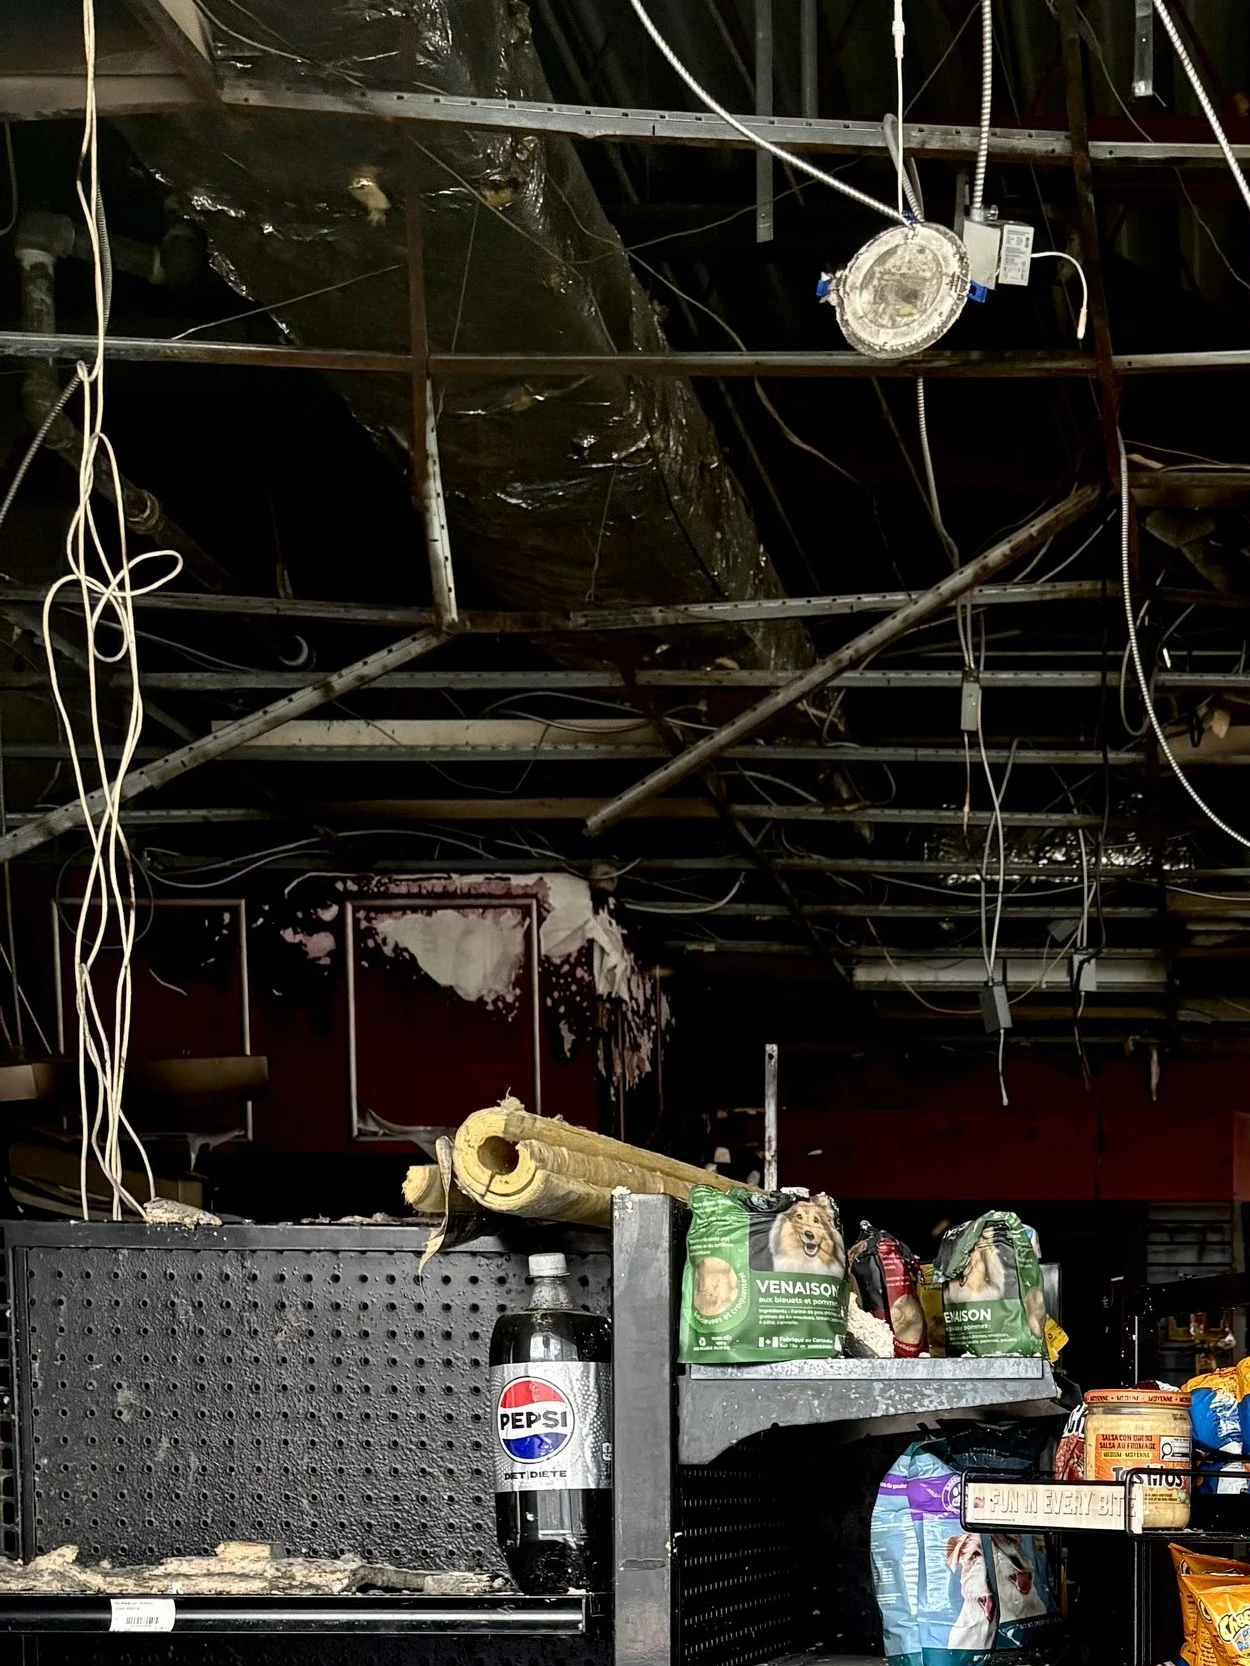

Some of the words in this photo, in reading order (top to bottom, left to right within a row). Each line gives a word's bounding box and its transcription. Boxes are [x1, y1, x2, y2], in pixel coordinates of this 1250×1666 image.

[756, 1279, 840, 1298] VENAISON
[943, 1308, 992, 1323] ENAISON
[500, 1410, 568, 1431] PEPSI
[1102, 1434, 1118, 1442] SALSA
[1119, 1434, 1131, 1442] CON
[1133, 1434, 1153, 1442] QUESO
[1127, 1442, 1156, 1450] FROMAGE
[991, 1489, 1019, 1514] FUN
[1023, 1490, 1038, 1514] IN
[1044, 1489, 1094, 1517] EVERY
